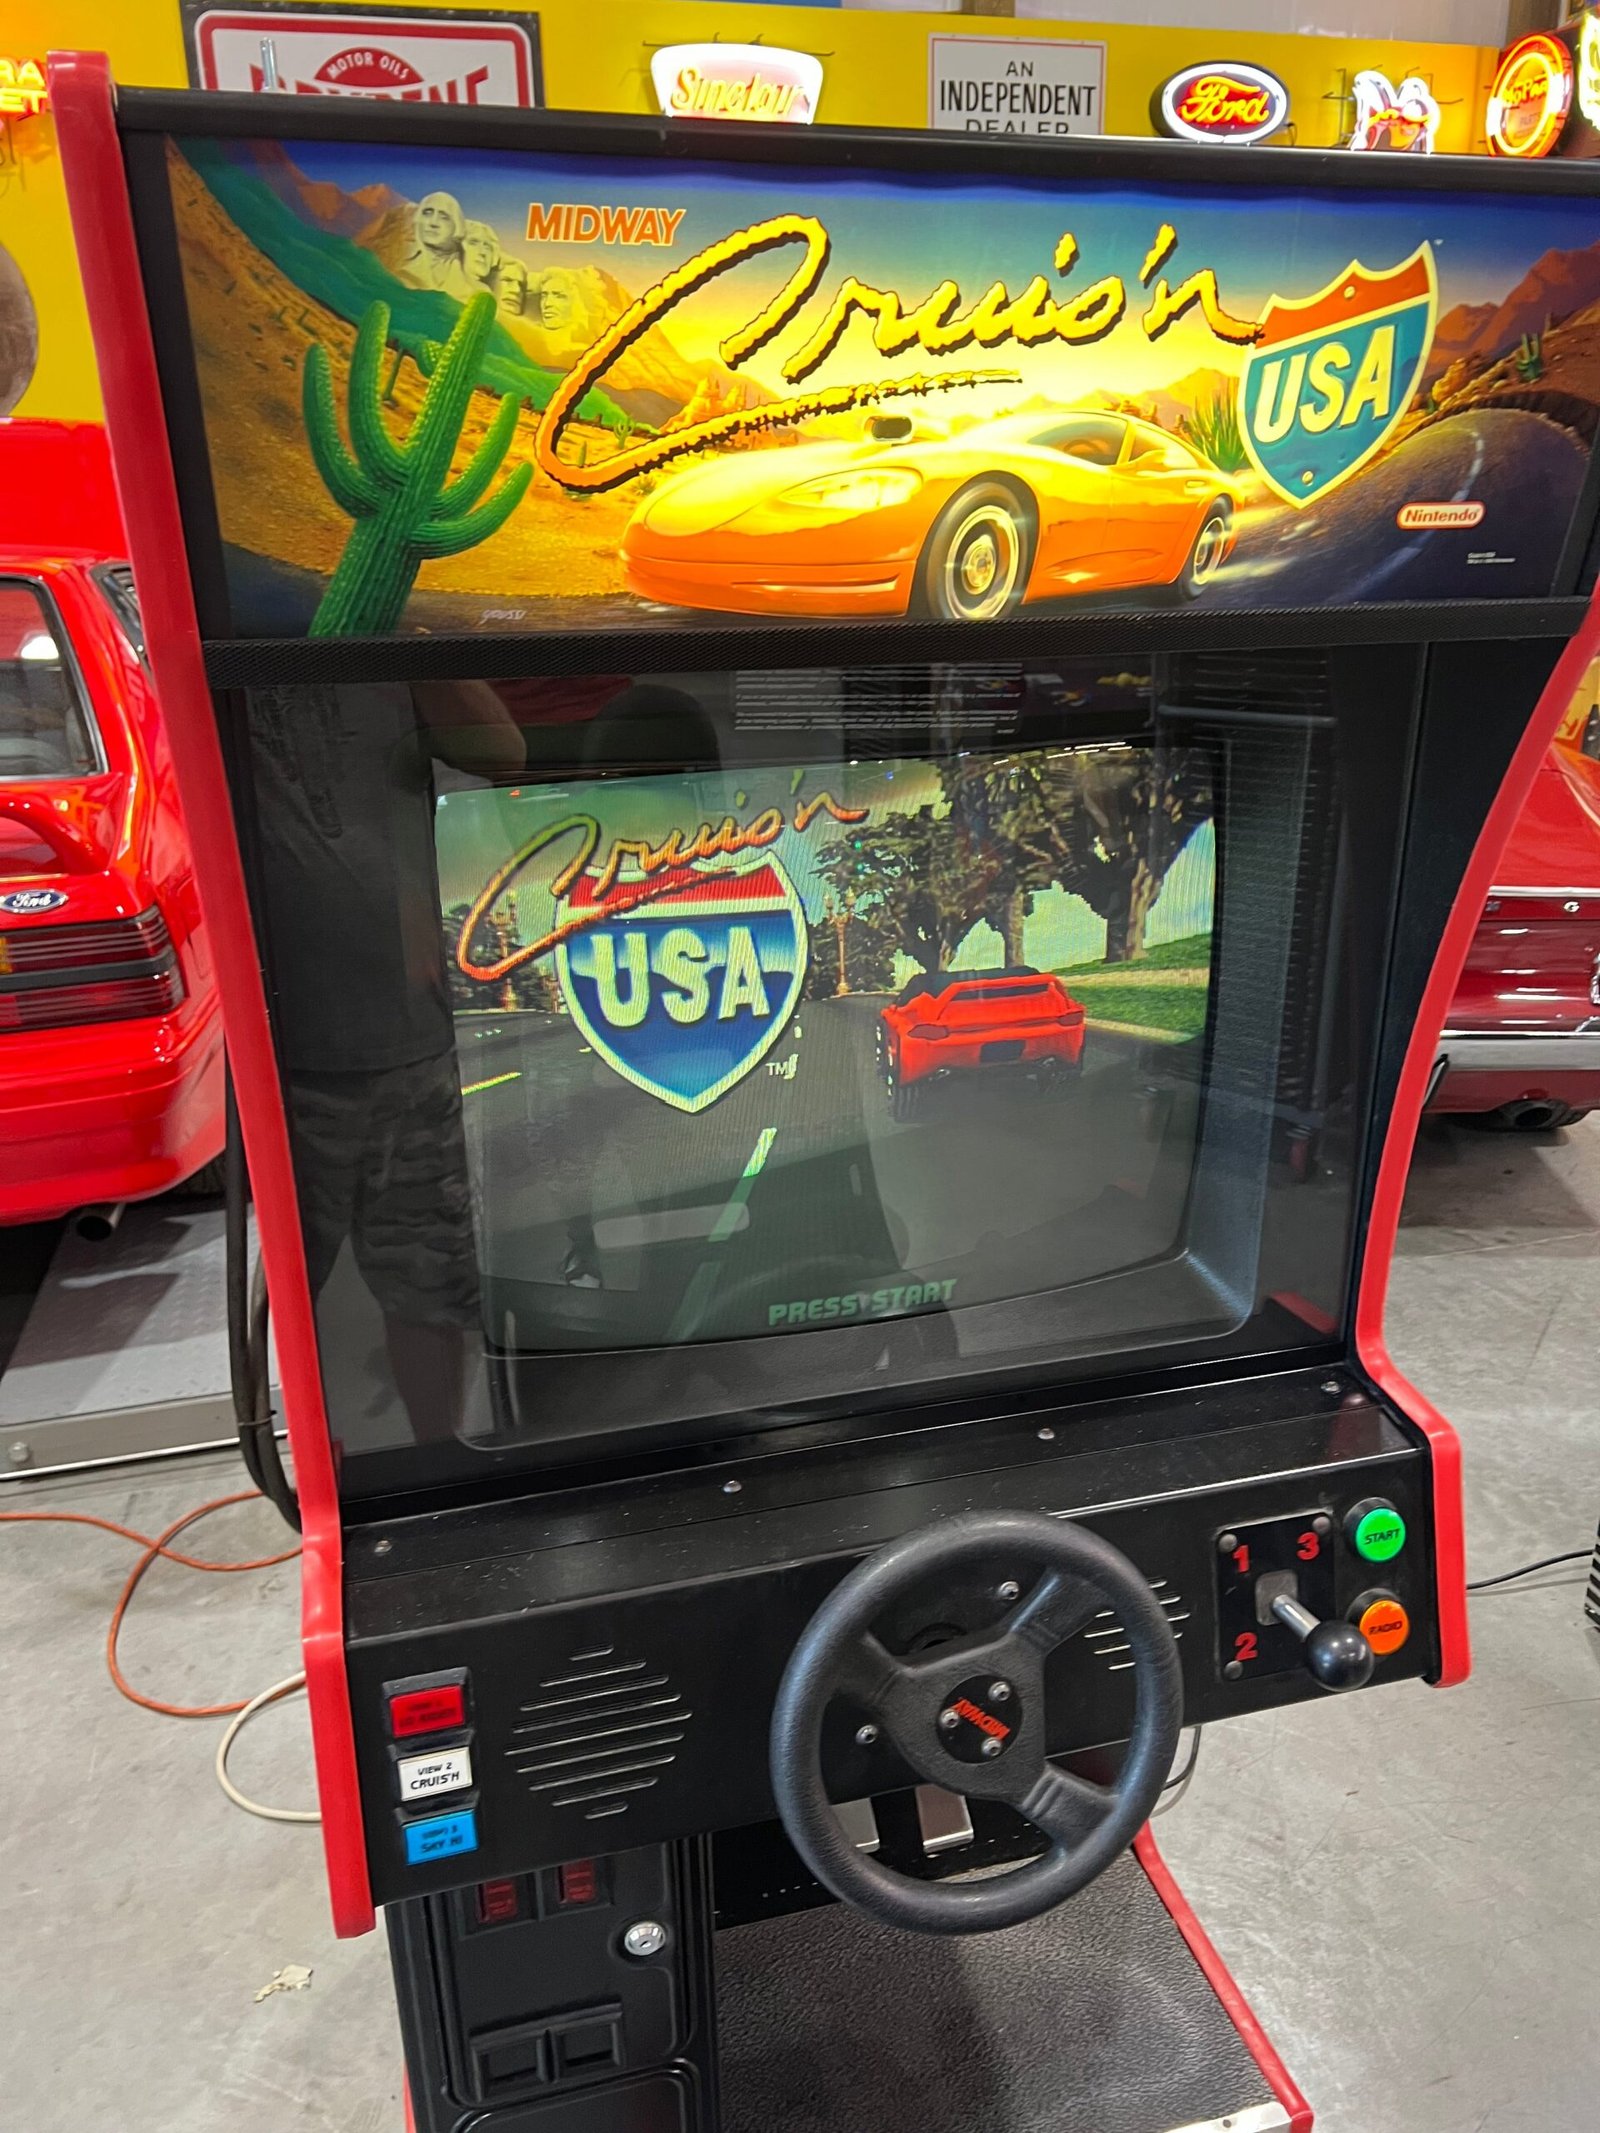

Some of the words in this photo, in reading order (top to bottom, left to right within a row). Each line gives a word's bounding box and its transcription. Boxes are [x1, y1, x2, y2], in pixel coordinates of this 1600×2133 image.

[326, 52, 375, 79] MOTOR
[379, 55, 409, 80] OILS
[1006, 60, 1034, 77] AN
[670, 63, 805, 117] Sinclair
[940, 80, 1097, 116] INDEPENDENT
[1181, 75, 1270, 122] Ford
[526, 203, 687, 246] MIDWAY
[534, 214, 1264, 494] Cruis'n
[1253, 325, 1396, 443] USA
[1404, 508, 1478, 523] Nintendo
[455, 768, 870, 982] Cruis'n
[12, 893, 51, 907] Ford
[590, 926, 771, 1028] USA
[768, 1294, 858, 1326] PRESS
[871, 1278, 958, 1312] START
[1296, 1532, 1320, 1560] 3
[1364, 1529, 1400, 1545] START
[1232, 1544, 1250, 1573] 1
[1235, 1632, 1258, 1661] 2
[417, 1764, 443, 1776] VIEW
[445, 1762, 453, 1770] 2
